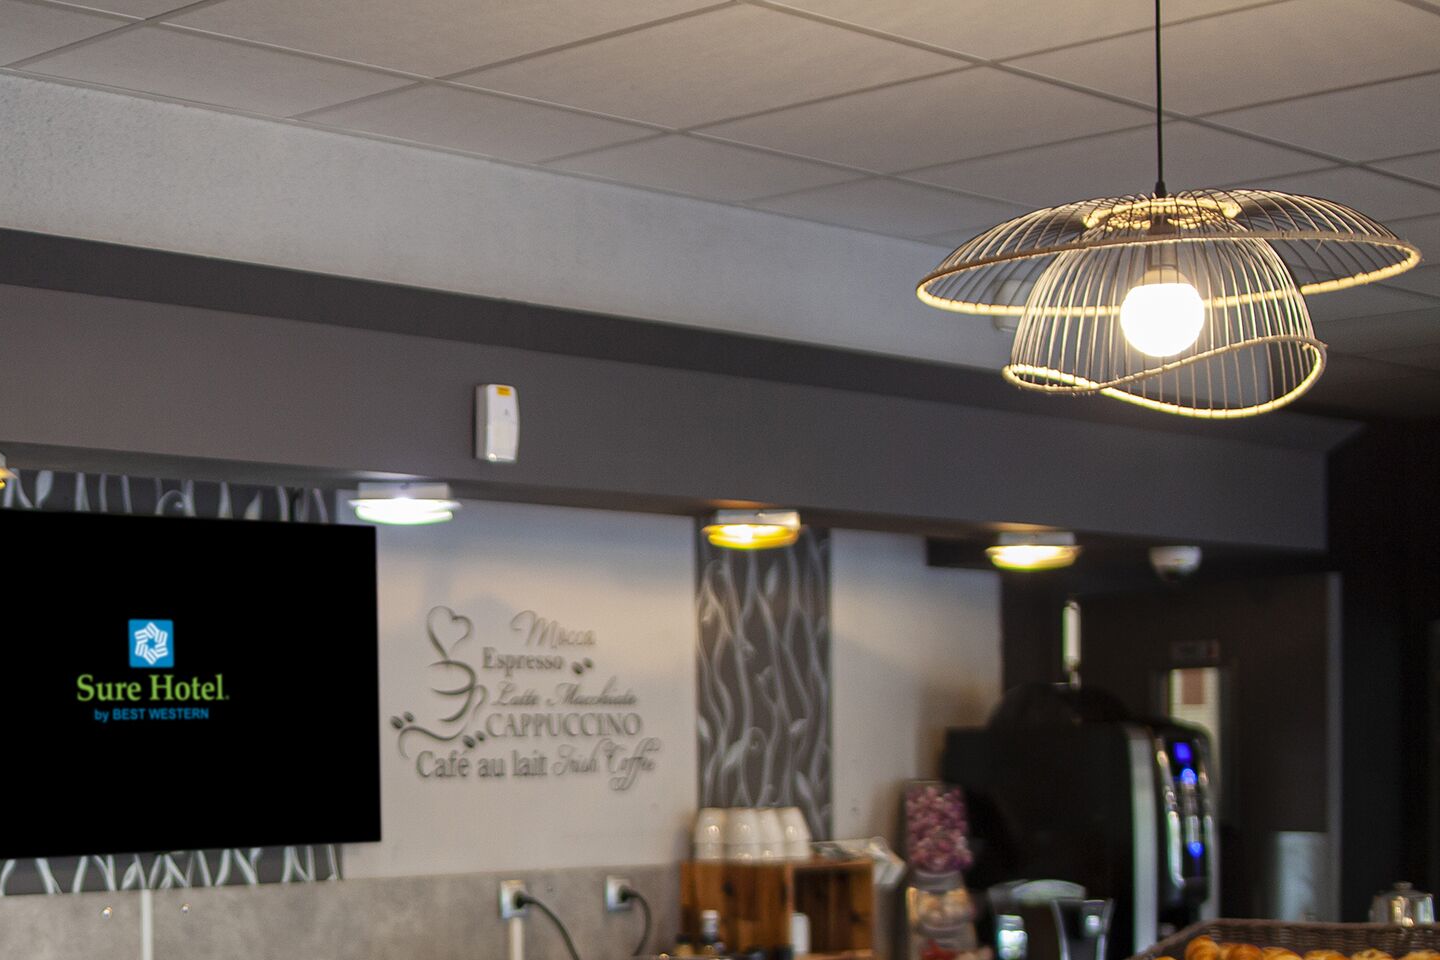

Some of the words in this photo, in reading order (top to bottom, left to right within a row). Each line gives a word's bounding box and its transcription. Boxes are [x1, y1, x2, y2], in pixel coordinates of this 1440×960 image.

[482, 647, 563, 677] Espresso
[76, 674, 142, 701] Sure
[149, 673, 224, 701] Hotel
[94, 709, 109, 723] by
[112, 708, 146, 721] BEST
[148, 708, 209, 721] WESTERN
[485, 712, 643, 738] CAPPUCCINO
[416, 750, 470, 778] Café
[478, 757, 505, 777] au
[512, 749, 548, 777] lait
